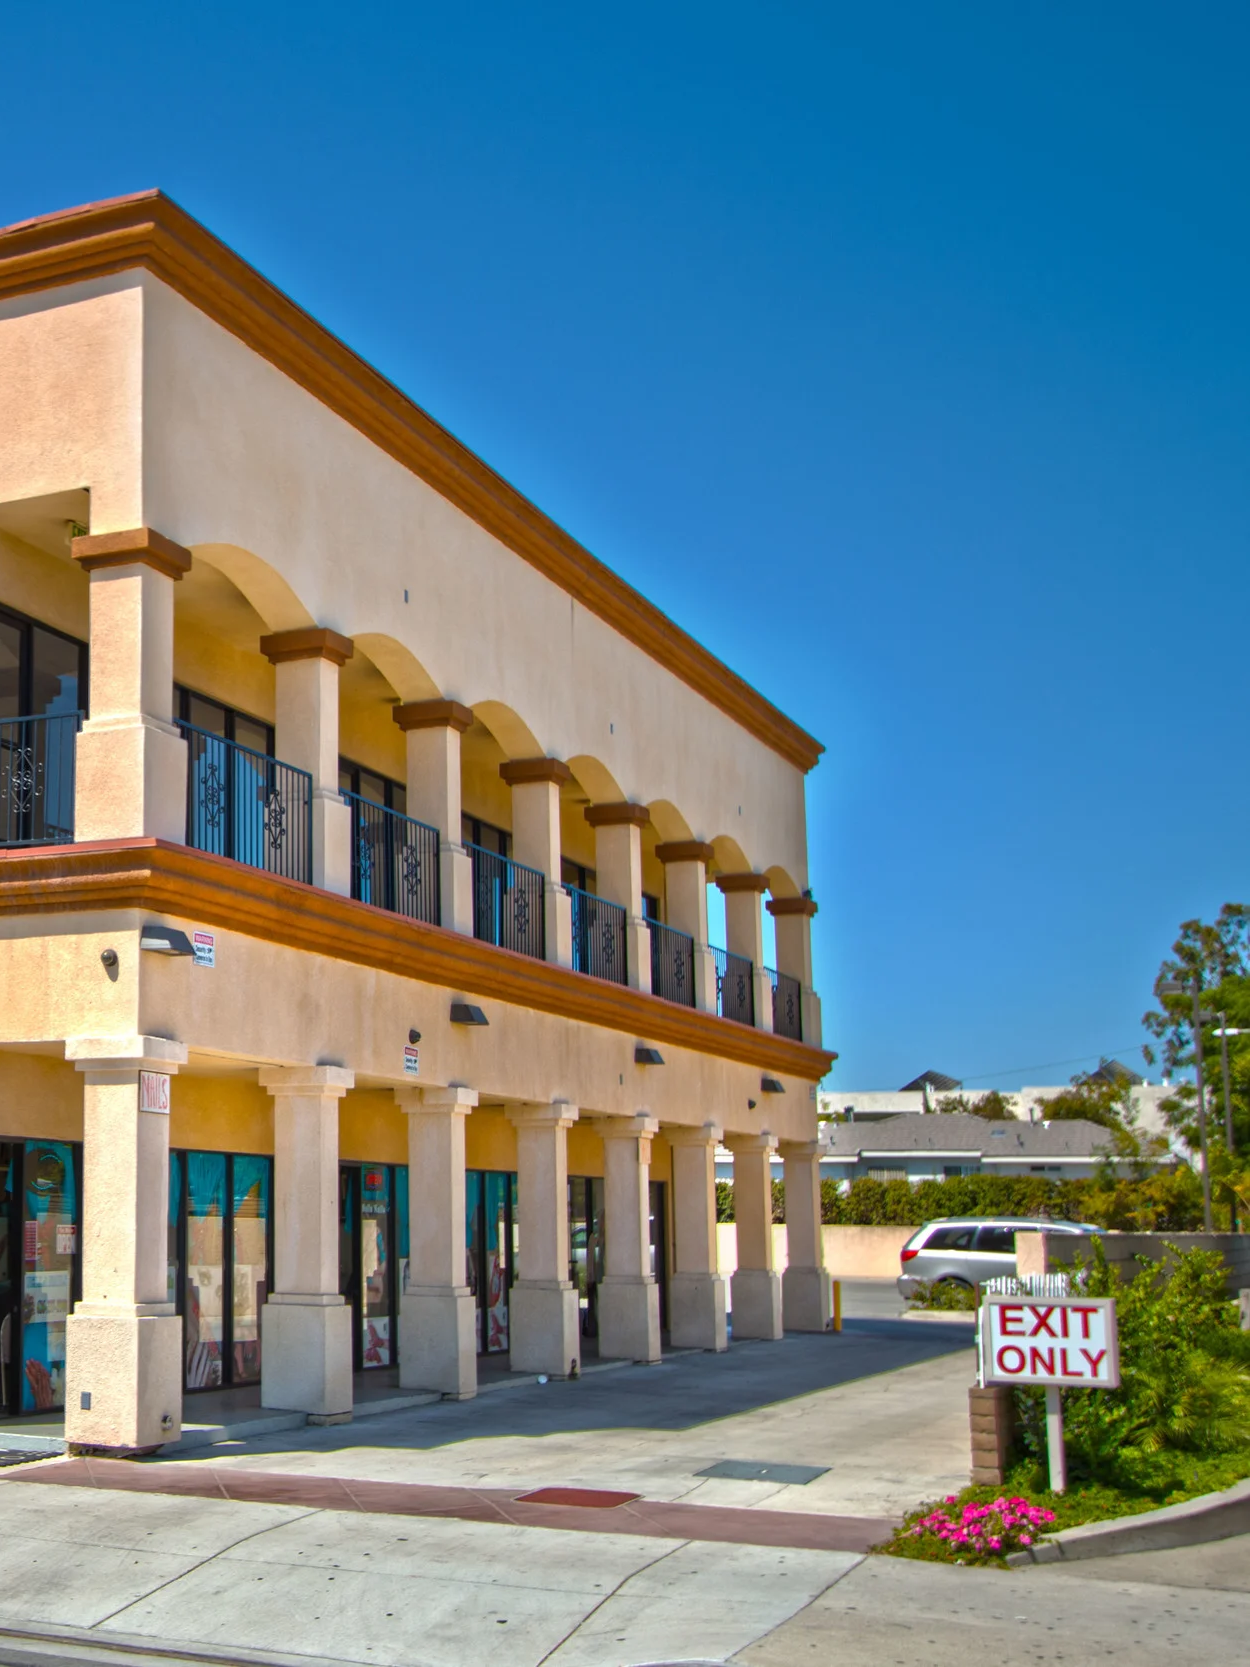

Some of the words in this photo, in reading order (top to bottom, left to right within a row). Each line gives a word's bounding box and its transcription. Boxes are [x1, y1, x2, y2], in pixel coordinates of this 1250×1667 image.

[141, 1074, 168, 1110] NAILS
[999, 1304, 1099, 1339] EXIT
[996, 1345, 1107, 1378] ONLY
